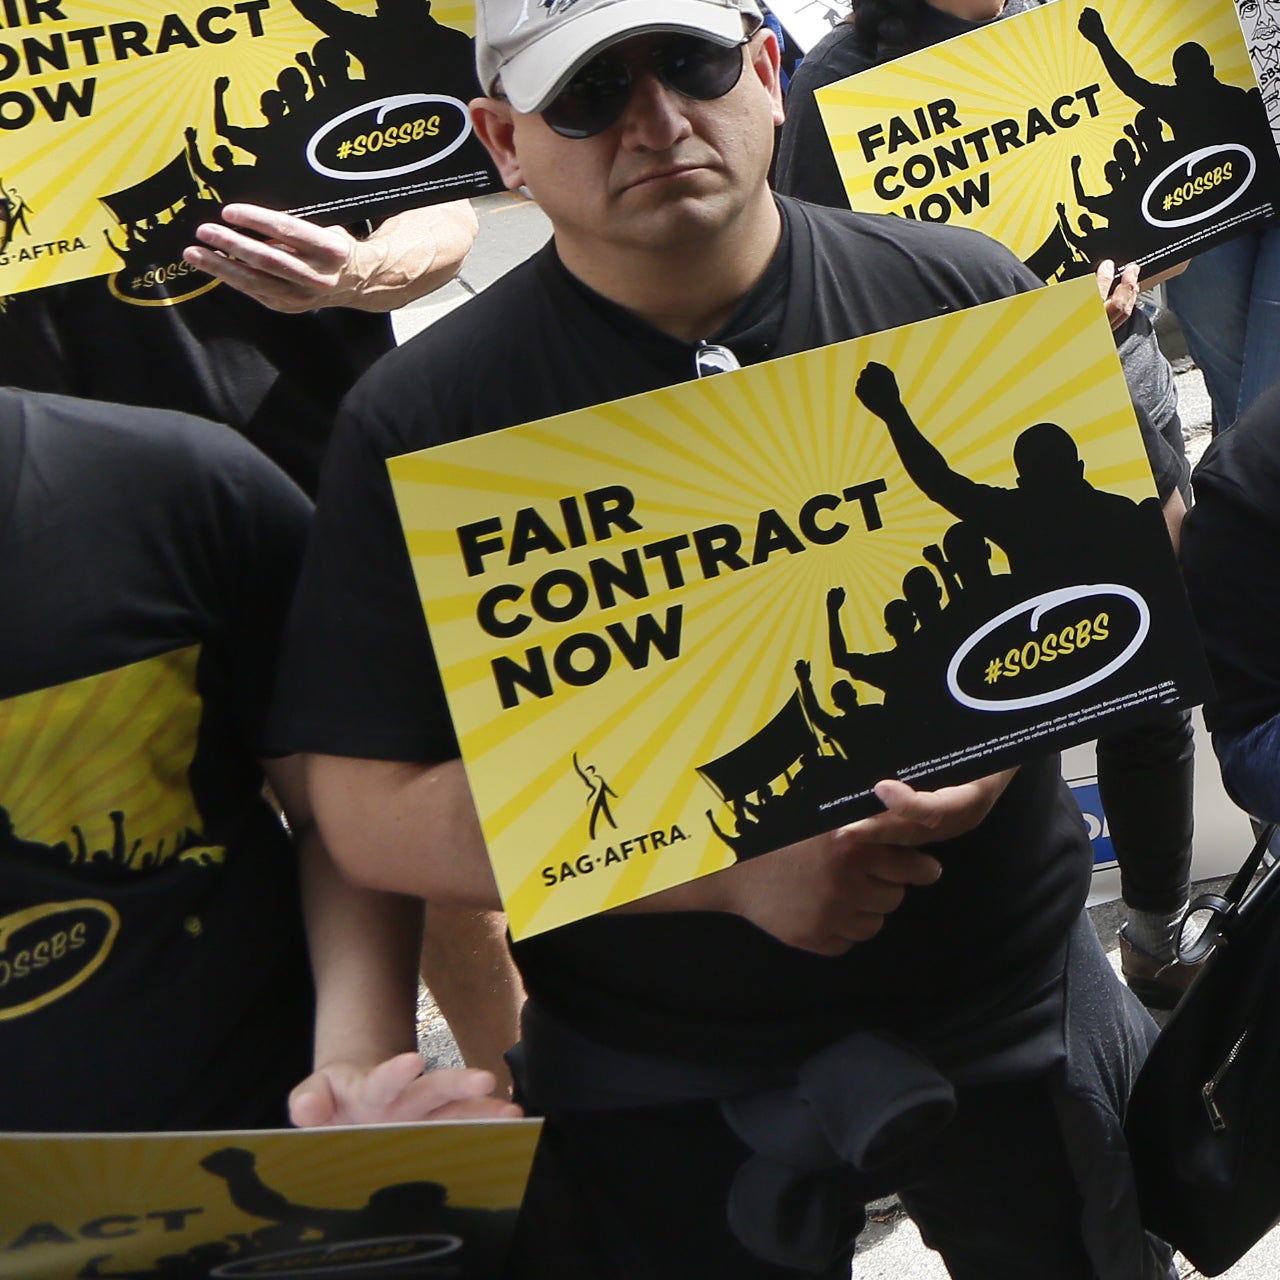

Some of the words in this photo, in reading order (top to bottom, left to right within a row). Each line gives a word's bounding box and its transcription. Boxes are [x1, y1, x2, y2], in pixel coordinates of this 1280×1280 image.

[0, 77, 97, 131] OW
[336, 114, 441, 160] #SOSSBS
[857, 98, 962, 163] FAIR
[873, 83, 1102, 201] CONTRACT
[1162, 160, 1234, 212] #SOSSBS
[455, 483, 644, 578] FAIR
[475, 477, 889, 639] CONTRACT
[489, 603, 686, 711] NOW
[983, 611, 1111, 686] #SOSSBS
[900, 769, 927, 783] ndividual
[1122, 695, 1148, 709] transport
[965, 741, 986, 755] dispute
[1010, 727, 1029, 739] person
[1053, 714, 1068, 725] other
[1081, 703, 1102, 717] Spanish
[1102, 691, 1138, 708] Broadcasting
[1138, 685, 1157, 698] System
[540, 823, 690, 889] SAG·AFTRA
